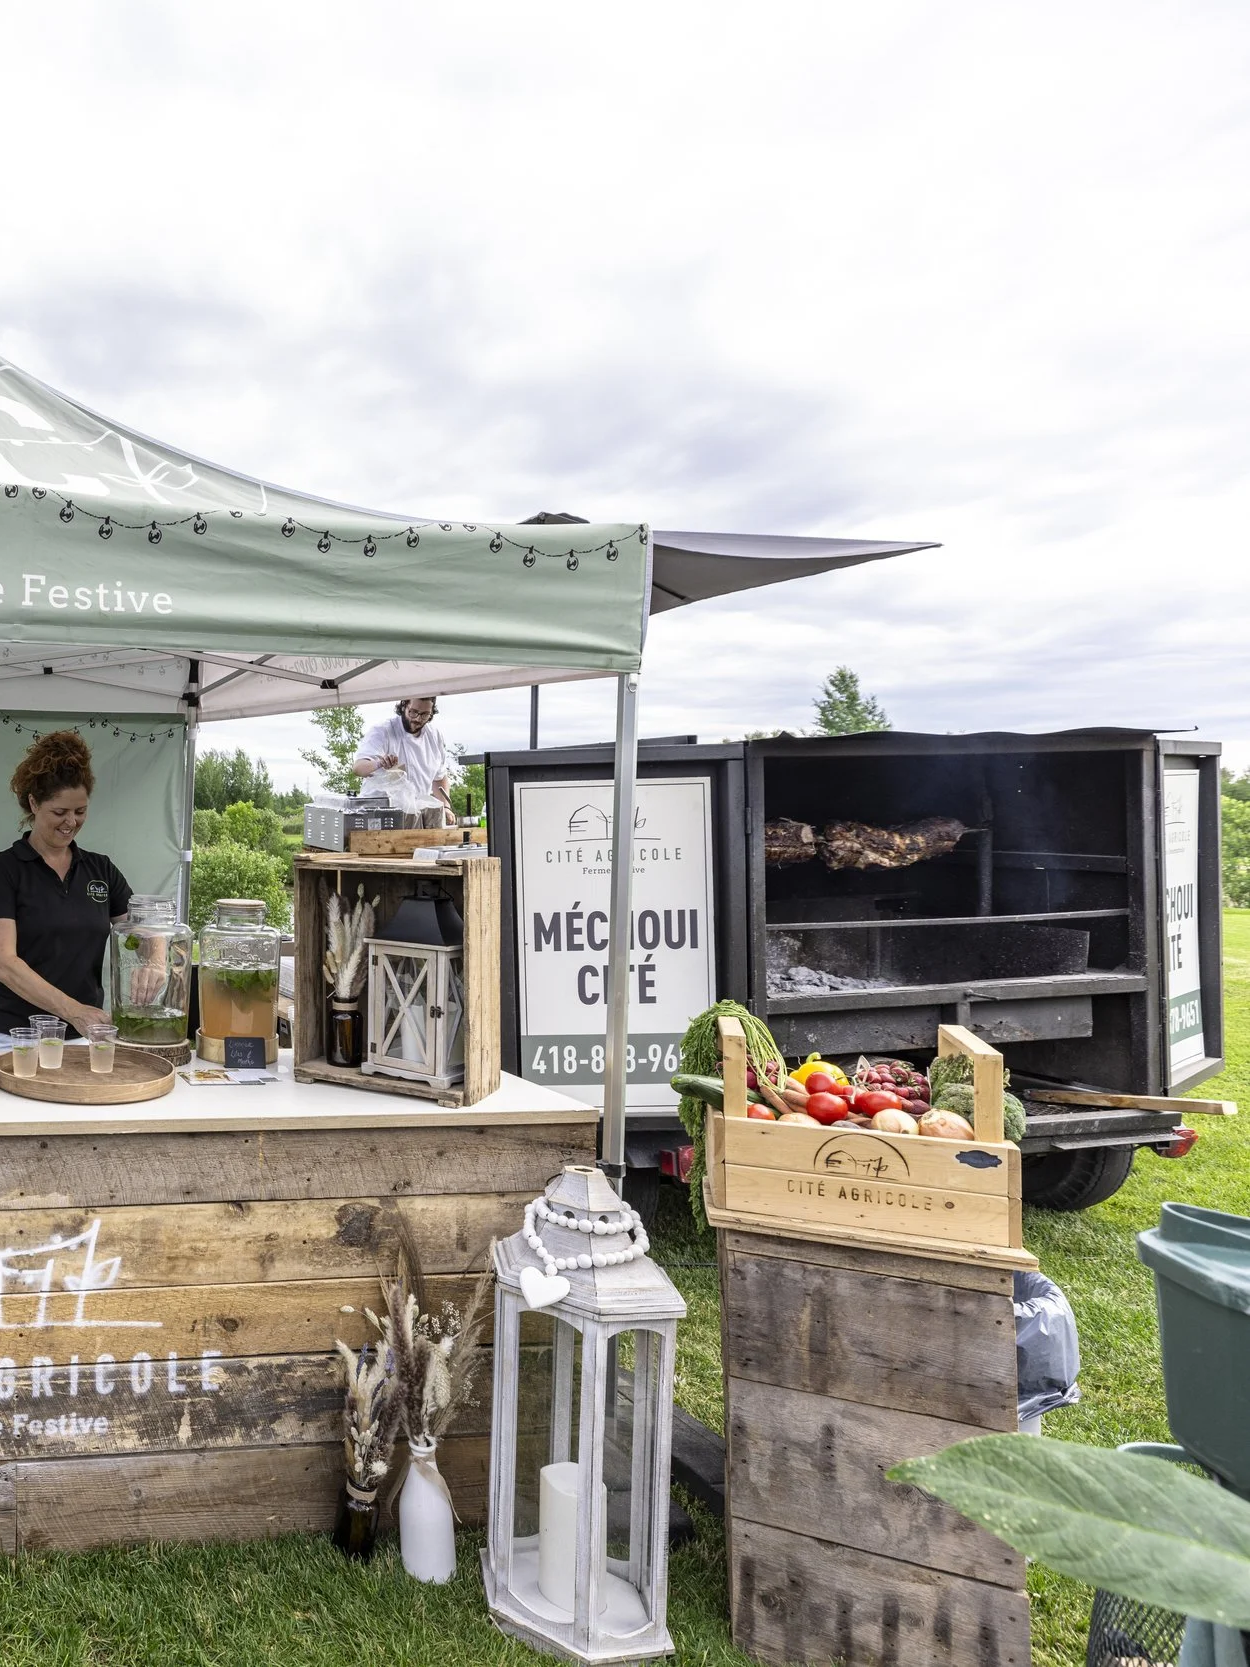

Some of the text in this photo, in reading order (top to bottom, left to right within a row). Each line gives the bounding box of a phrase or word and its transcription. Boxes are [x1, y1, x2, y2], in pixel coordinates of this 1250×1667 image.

[21, 573, 173, 615] Festive
[546, 847, 682, 863] CITÉ AGCOLE
[582, 866, 612, 875] Ferme
[533, 901, 699, 953] MÉCOUI
[577, 953, 657, 1006] CIÉ
[531, 1043, 686, 1074] 418-88-96
[787, 1179, 933, 1212] CITÉ AGRICOLE
[12, 1413, 109, 1438] Festive
